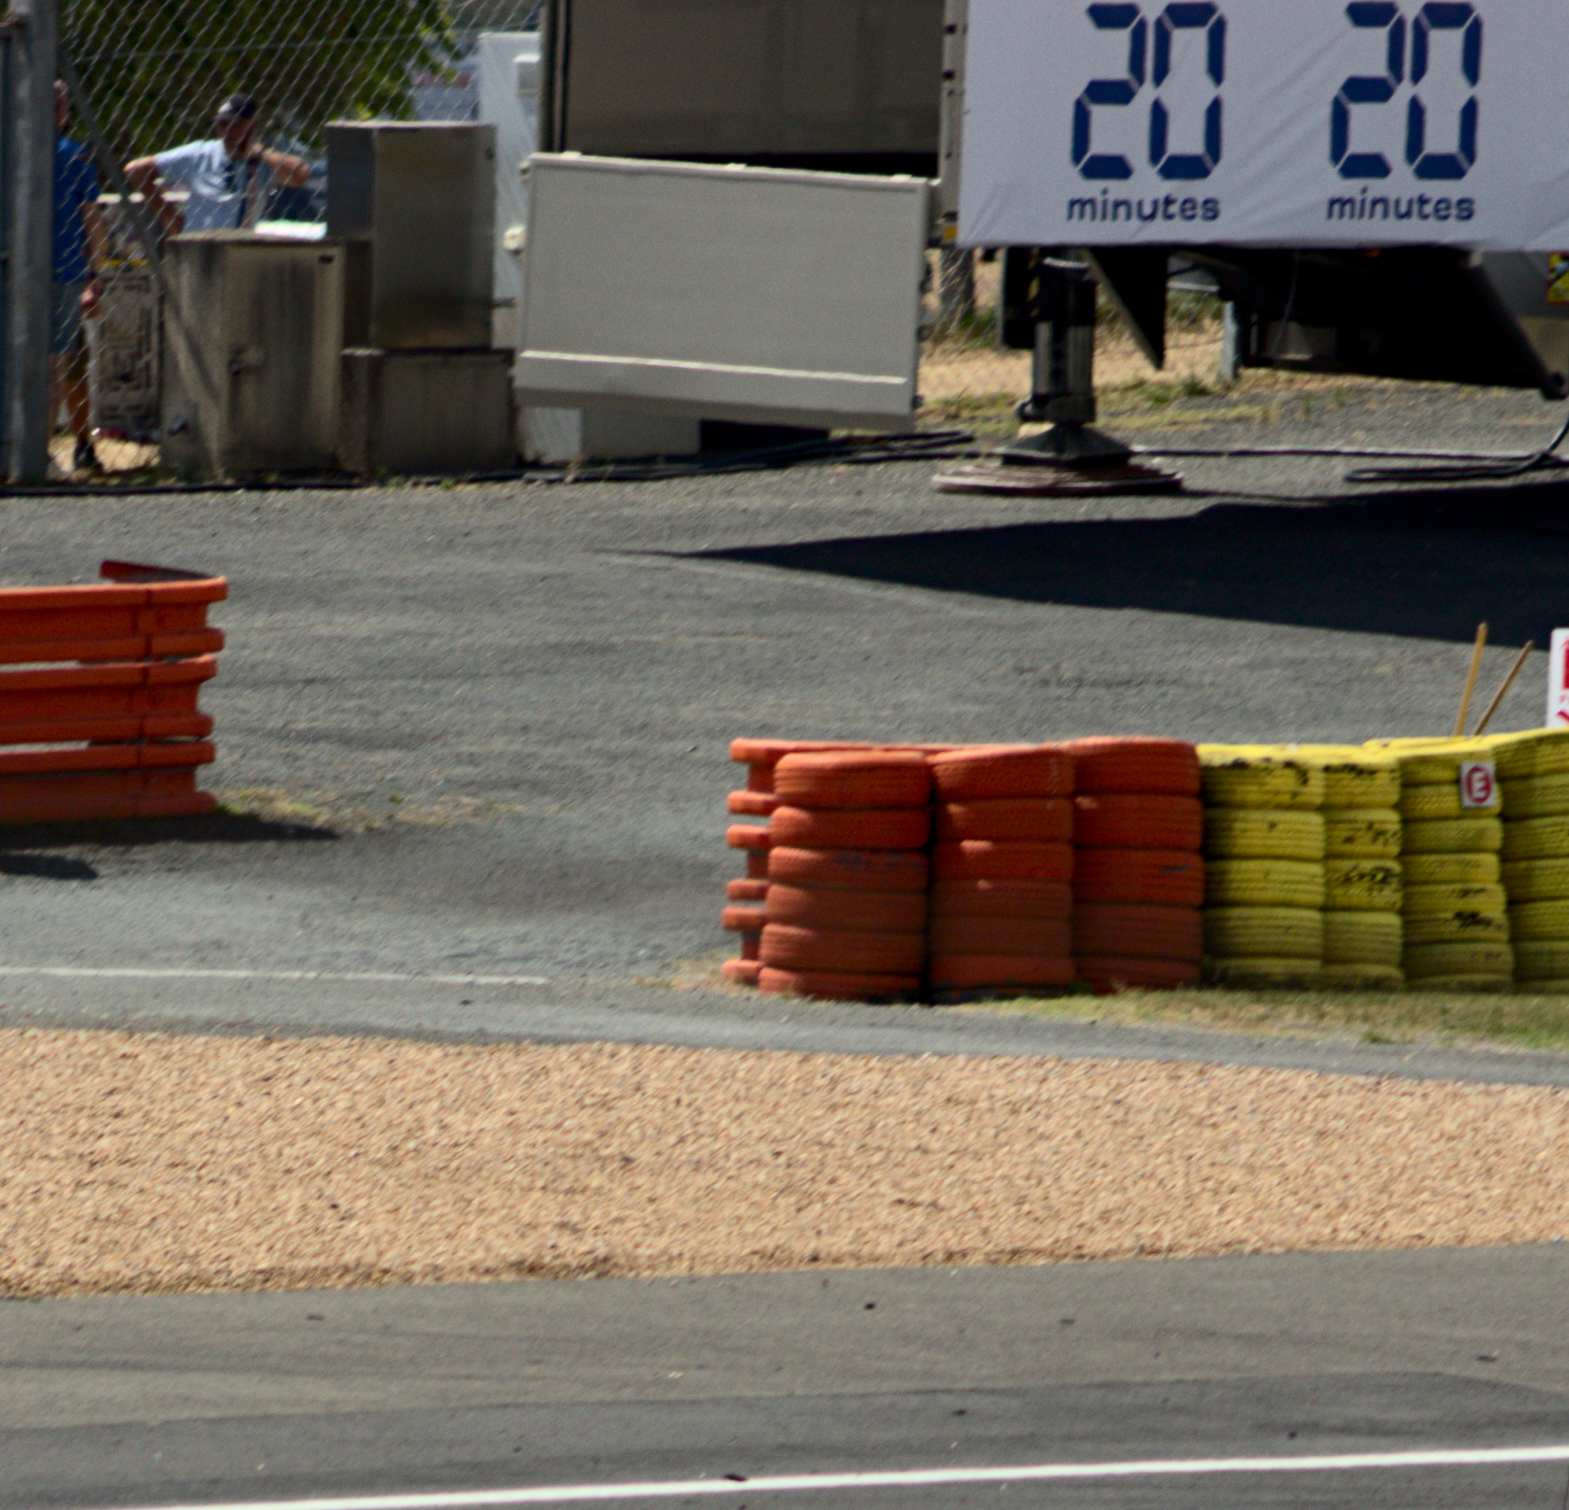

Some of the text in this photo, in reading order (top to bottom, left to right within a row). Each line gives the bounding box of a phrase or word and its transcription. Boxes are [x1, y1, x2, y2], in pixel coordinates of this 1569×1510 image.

[1071, 2, 1226, 181] 20
[1329, 1, 1482, 181] 20
[1066, 186, 1221, 223] minutes
[1325, 186, 1476, 222] minutes
